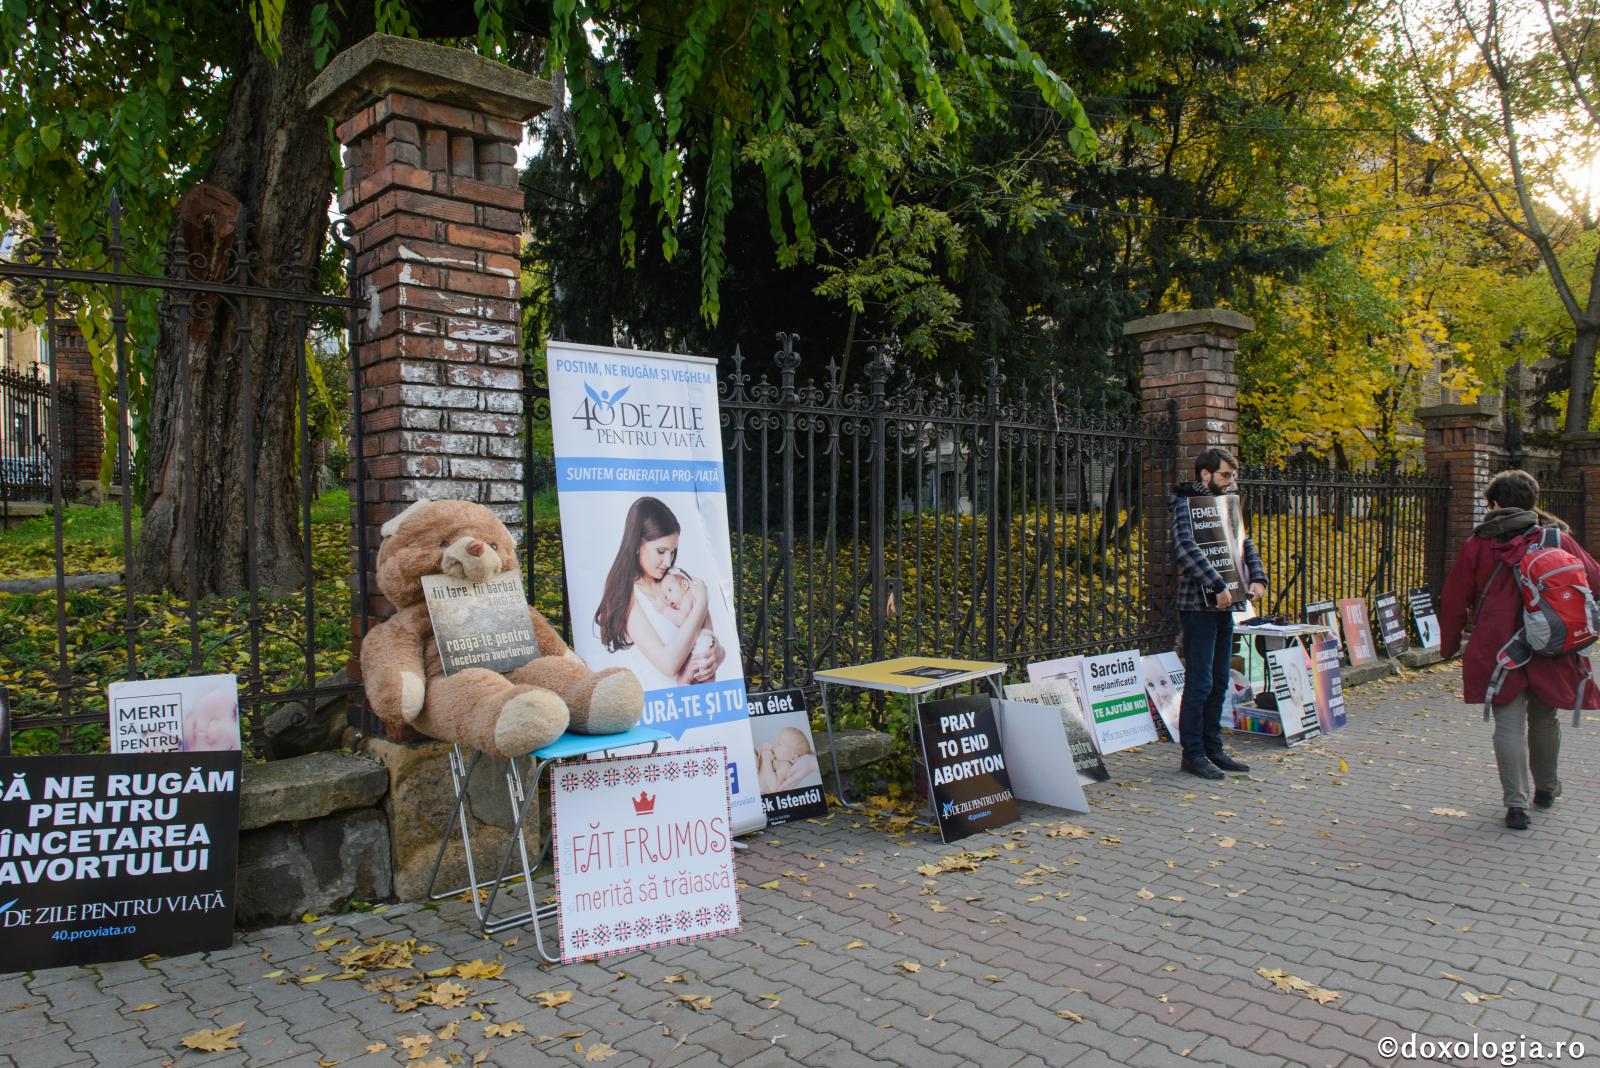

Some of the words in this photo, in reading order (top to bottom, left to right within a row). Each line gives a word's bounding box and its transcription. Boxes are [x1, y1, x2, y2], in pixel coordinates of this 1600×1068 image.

[605, 363, 619, 377] NE
[620, 365, 658, 380] RUGĂM
[672, 369, 711, 385] VEGHEM
[572, 396, 615, 431] 40
[620, 402, 652, 429] DE
[656, 404, 704, 431] ZILE
[597, 428, 658, 447] PENTRU
[566, 467, 613, 481] SUNTEM
[616, 467, 670, 484] GENERAȚIA
[1192, 506, 1222, 519] FEMEIL
[432, 586, 445, 600] fii
[473, 581, 484, 595] fii
[446, 633, 493, 653] roagă-te
[495, 629, 530, 648] pentru
[450, 652, 491, 667] încetarea
[492, 645, 535, 660] avorturilor
[1090, 657, 1135, 678] Sarcină
[1092, 675, 1137, 693] neplanificată?
[119, 704, 179, 721] MERIT
[705, 692, 721, 721] ȘI
[723, 688, 743, 711] TU
[767, 693, 795, 713] élet
[1094, 708, 1104, 719] TE
[1105, 700, 1134, 715] AJUTĂM
[120, 723, 137, 736] SĂ
[940, 712, 976, 734] PRAY
[120, 735, 179, 751] PENTRU
[937, 740, 958, 759] TO
[961, 733, 989, 751] END
[934, 754, 1005, 786] ABORTION
[44, 776, 95, 800] NE
[107, 766, 235, 797] RUGĂM
[776, 788, 822, 811] Istentől
[960, 801, 973, 813] ZILE
[972, 795, 995, 809] PENTRU
[28, 798, 179, 827] PENTRU
[0, 823, 211, 858] ÎNCETAREA
[572, 821, 615, 874] FĂT
[624, 817, 727, 867] FRUMOS
[0, 849, 209, 885] AVORTULUI
[575, 877, 633, 913] merită
[639, 873, 658, 902] să
[663, 864, 730, 894] trăiască
[3, 908, 31, 928] DE
[34, 904, 77, 925] ZILE
[80, 896, 163, 921] PENTRU
[166, 890, 226, 914] VIAȚĂ
[51, 924, 137, 942] 40.proviata.ro
